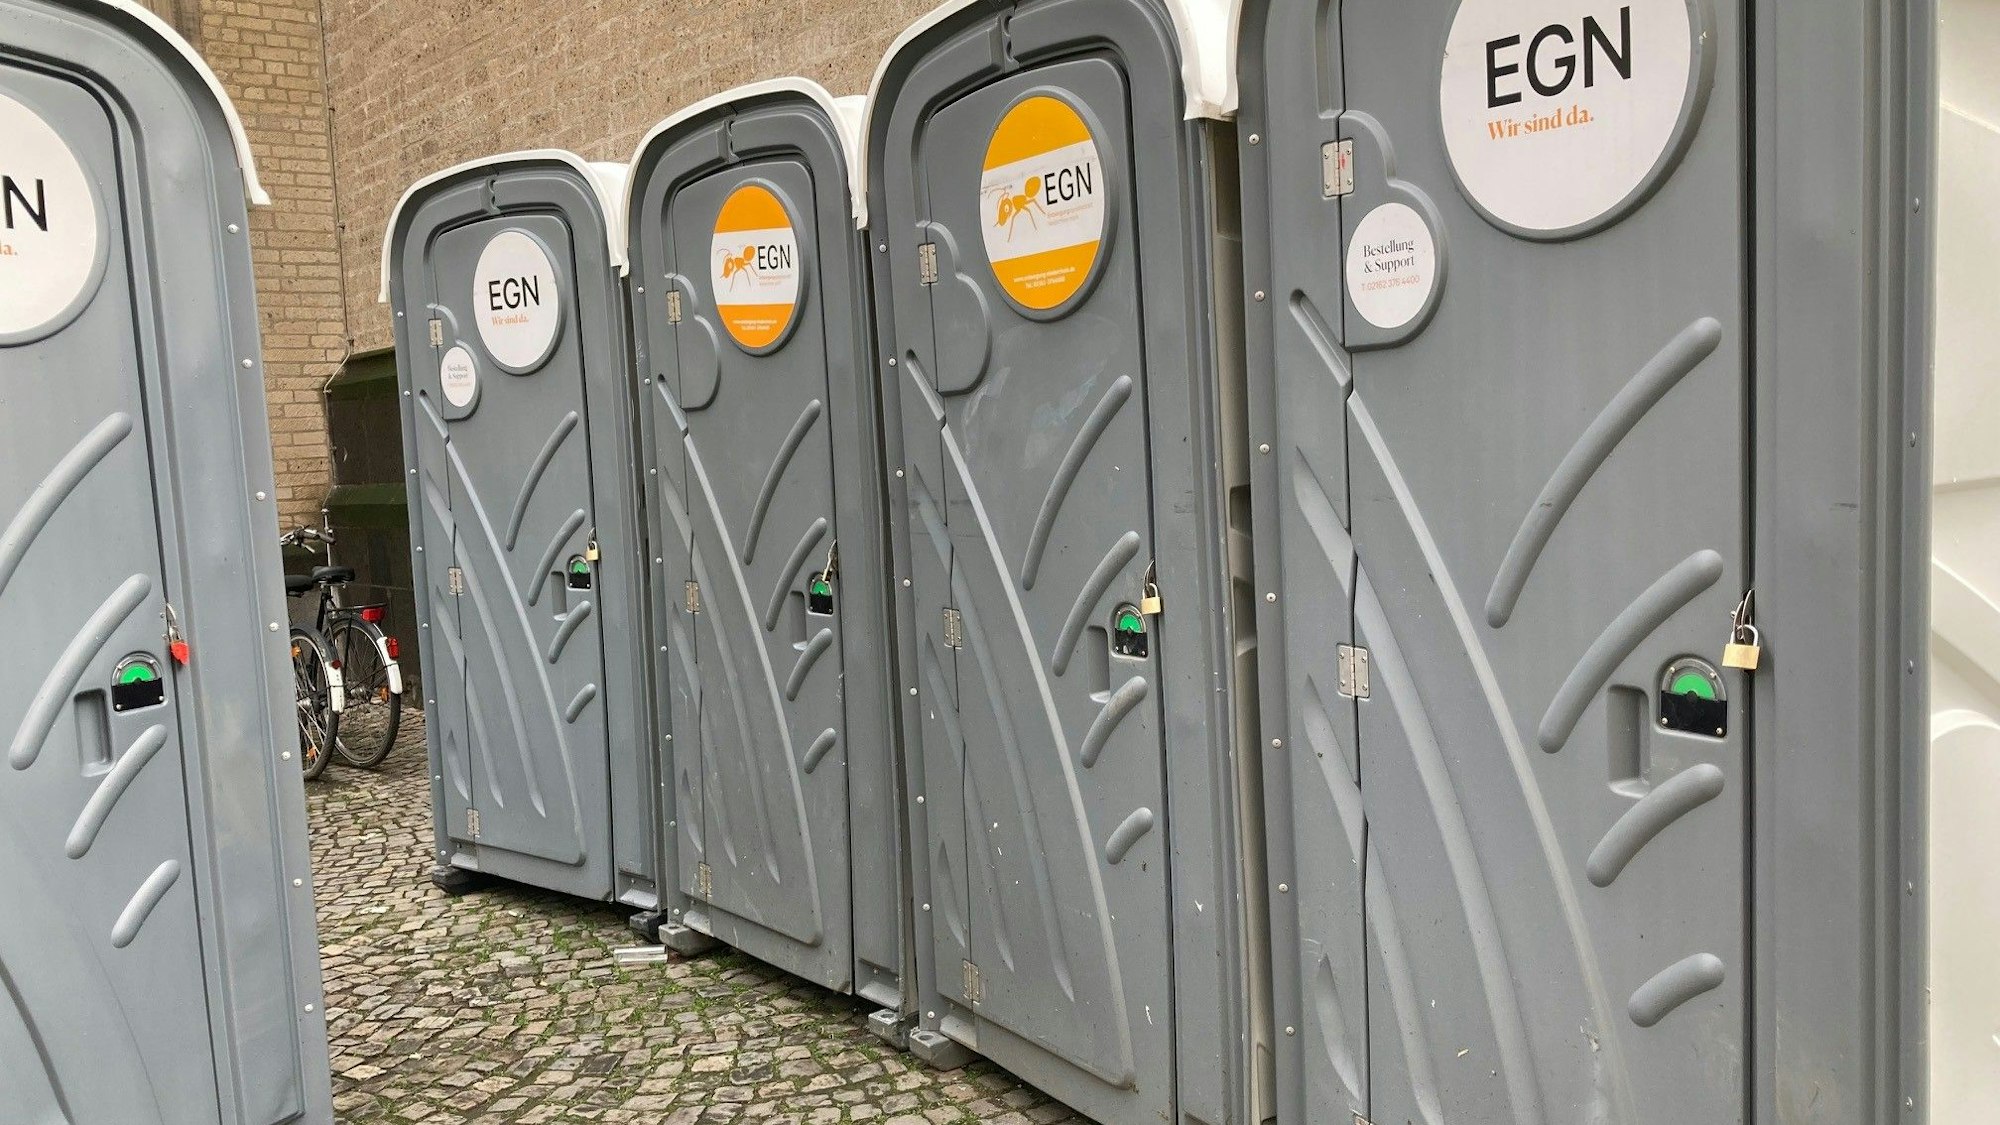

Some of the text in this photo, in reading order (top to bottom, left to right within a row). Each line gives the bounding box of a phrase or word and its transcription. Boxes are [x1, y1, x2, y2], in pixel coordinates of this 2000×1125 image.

[1485, 5, 1632, 109] EGN
[1487, 104, 1594, 140] Wir sind da.
[1044, 162, 1092, 206] EGN
[757, 243, 791, 270] EGN
[1363, 239, 1415, 258] Bestellung
[1364, 256, 1415, 274] & Support
[488, 275, 540, 311] EGN
